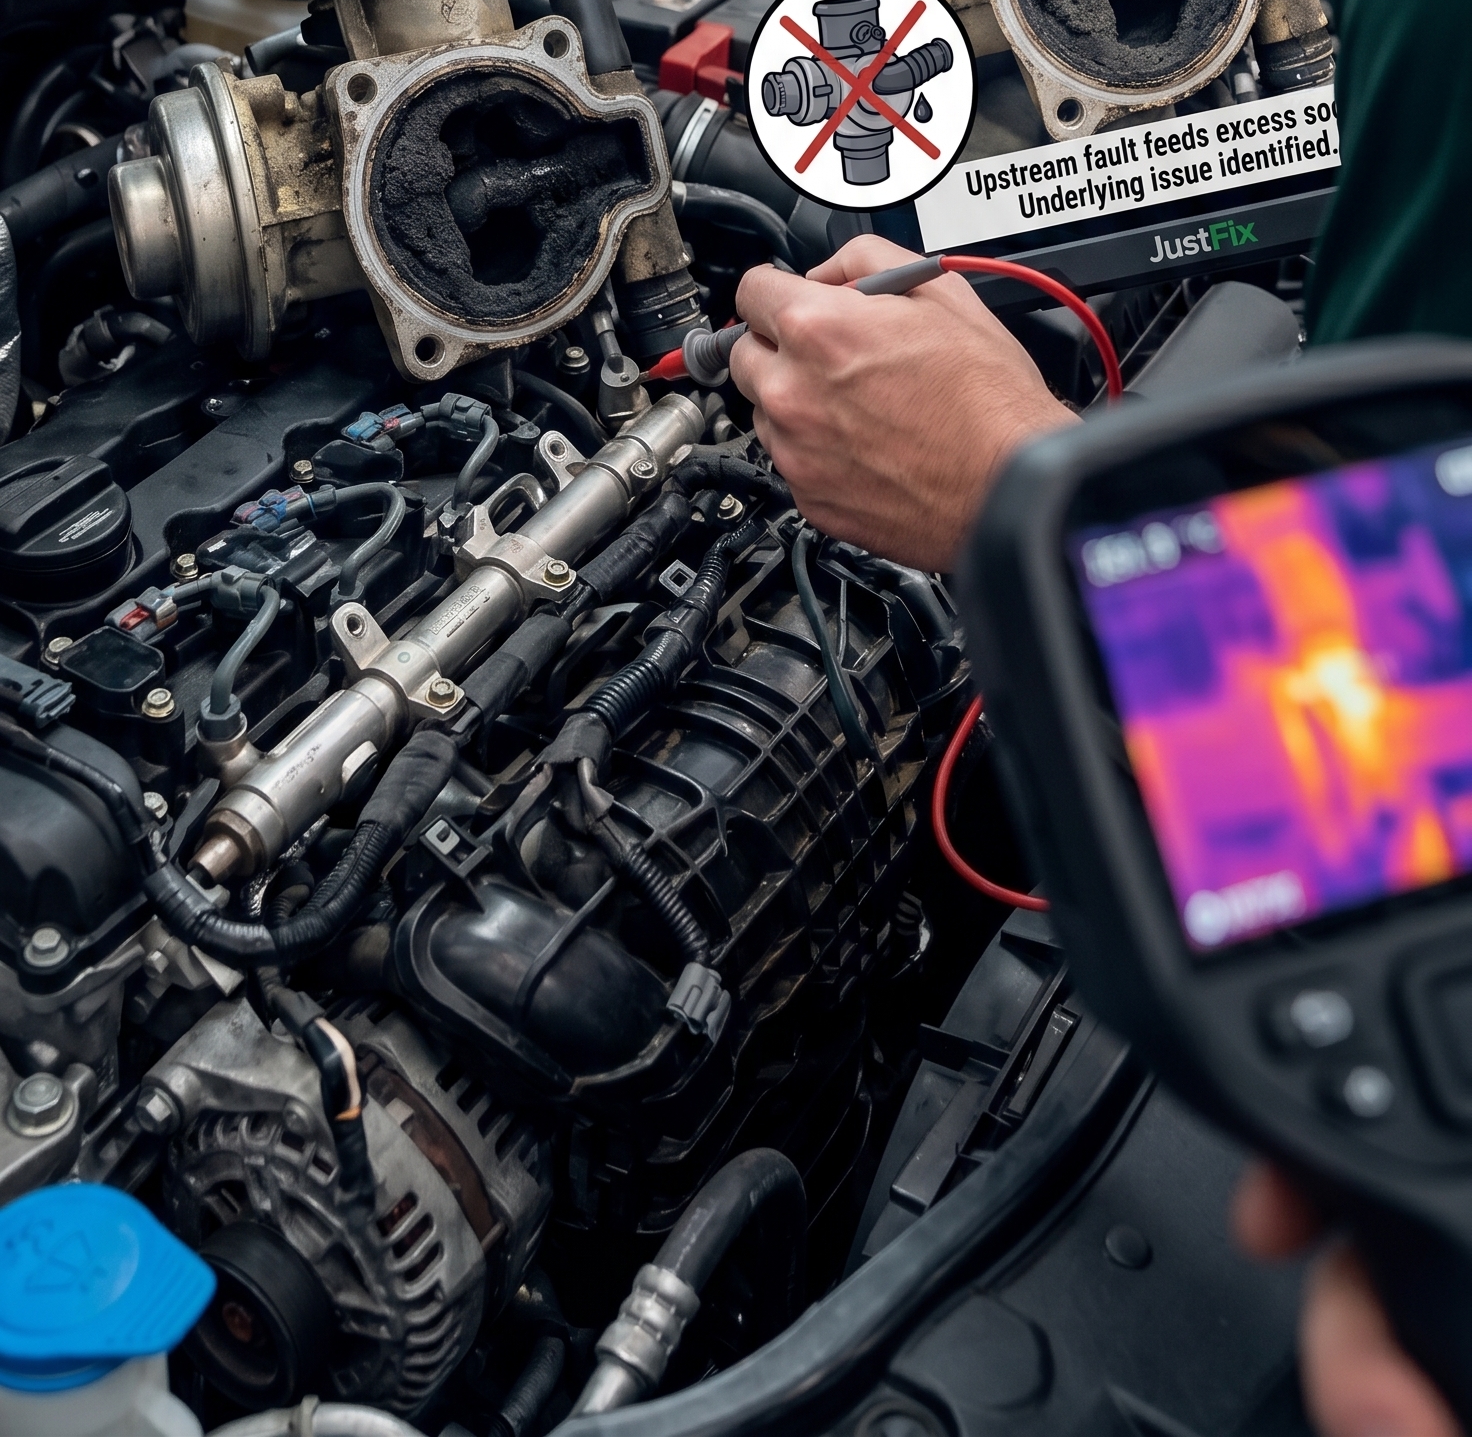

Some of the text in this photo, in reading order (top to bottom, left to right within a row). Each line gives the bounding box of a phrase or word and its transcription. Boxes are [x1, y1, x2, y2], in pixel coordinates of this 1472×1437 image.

[965, 153, 1078, 200] Upstream
[1083, 137, 1139, 171] fault
[1144, 123, 1209, 159] feeds
[1216, 109, 1297, 143] excess
[1018, 129, 1339, 218] Underlying issue identified.
[1150, 219, 1259, 263] JustFix
